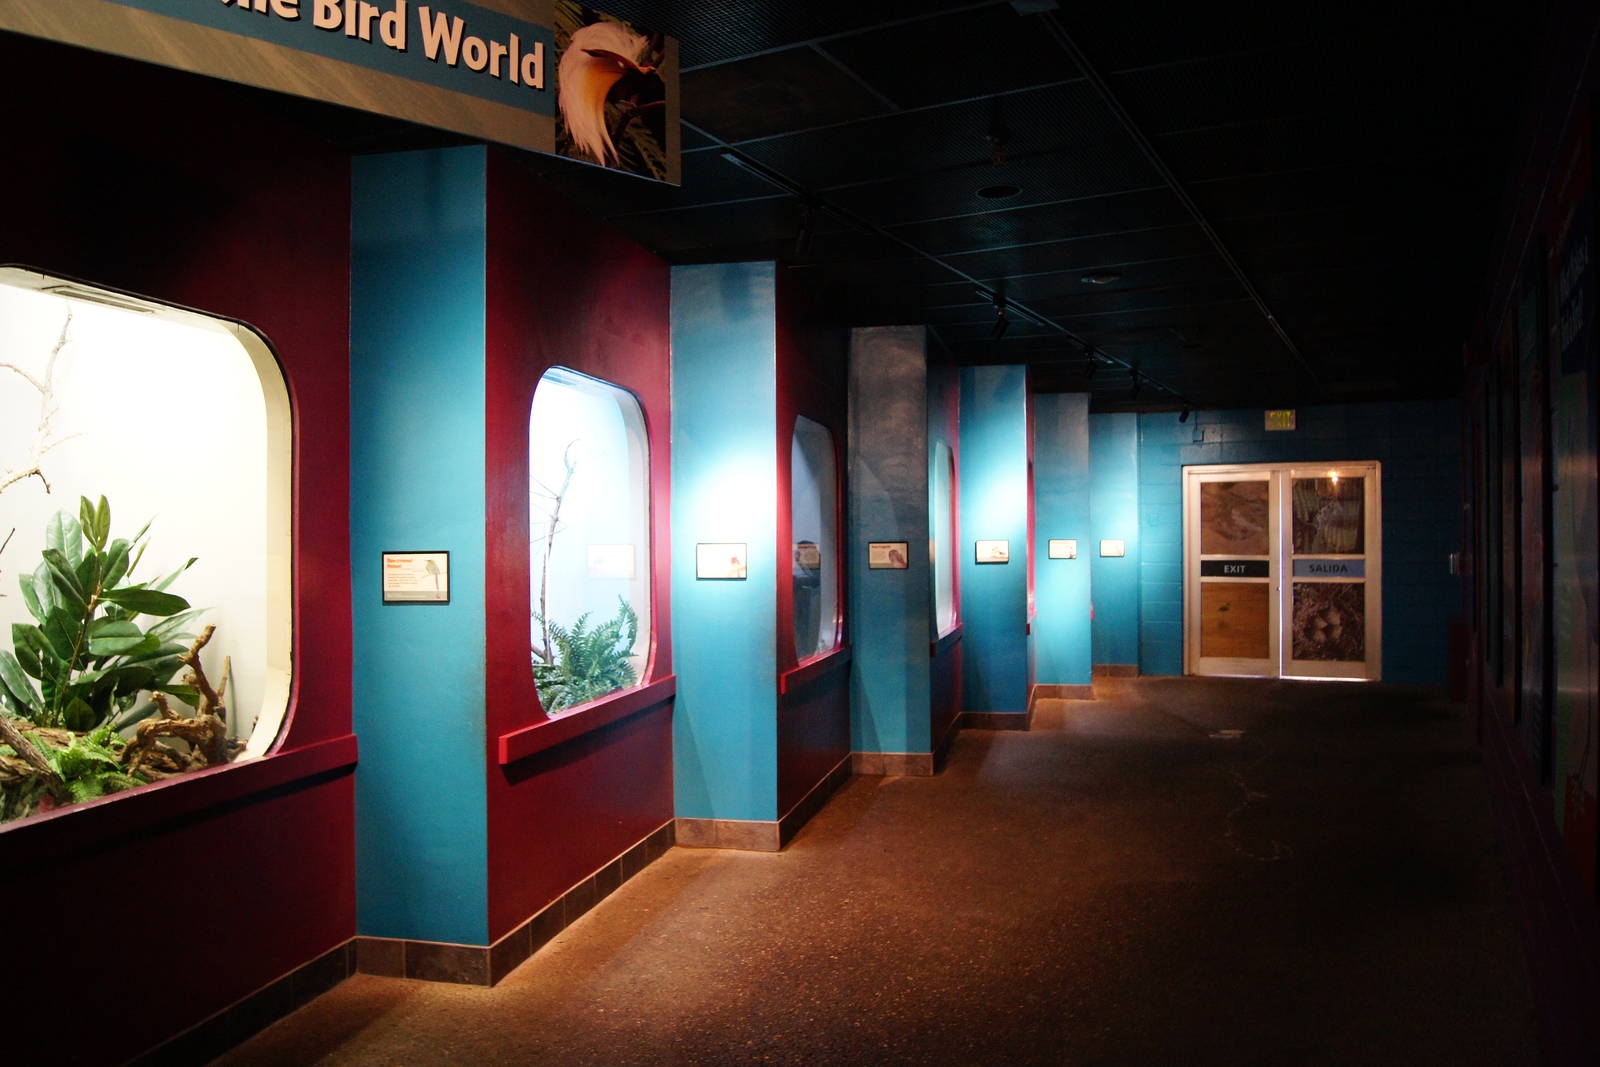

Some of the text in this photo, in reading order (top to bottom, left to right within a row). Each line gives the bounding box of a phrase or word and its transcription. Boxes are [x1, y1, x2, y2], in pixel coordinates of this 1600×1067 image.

[312, 0, 544, 89] Bird World
[1223, 564, 1246, 574] EXIT
[1309, 564, 1348, 574] SALIDA
